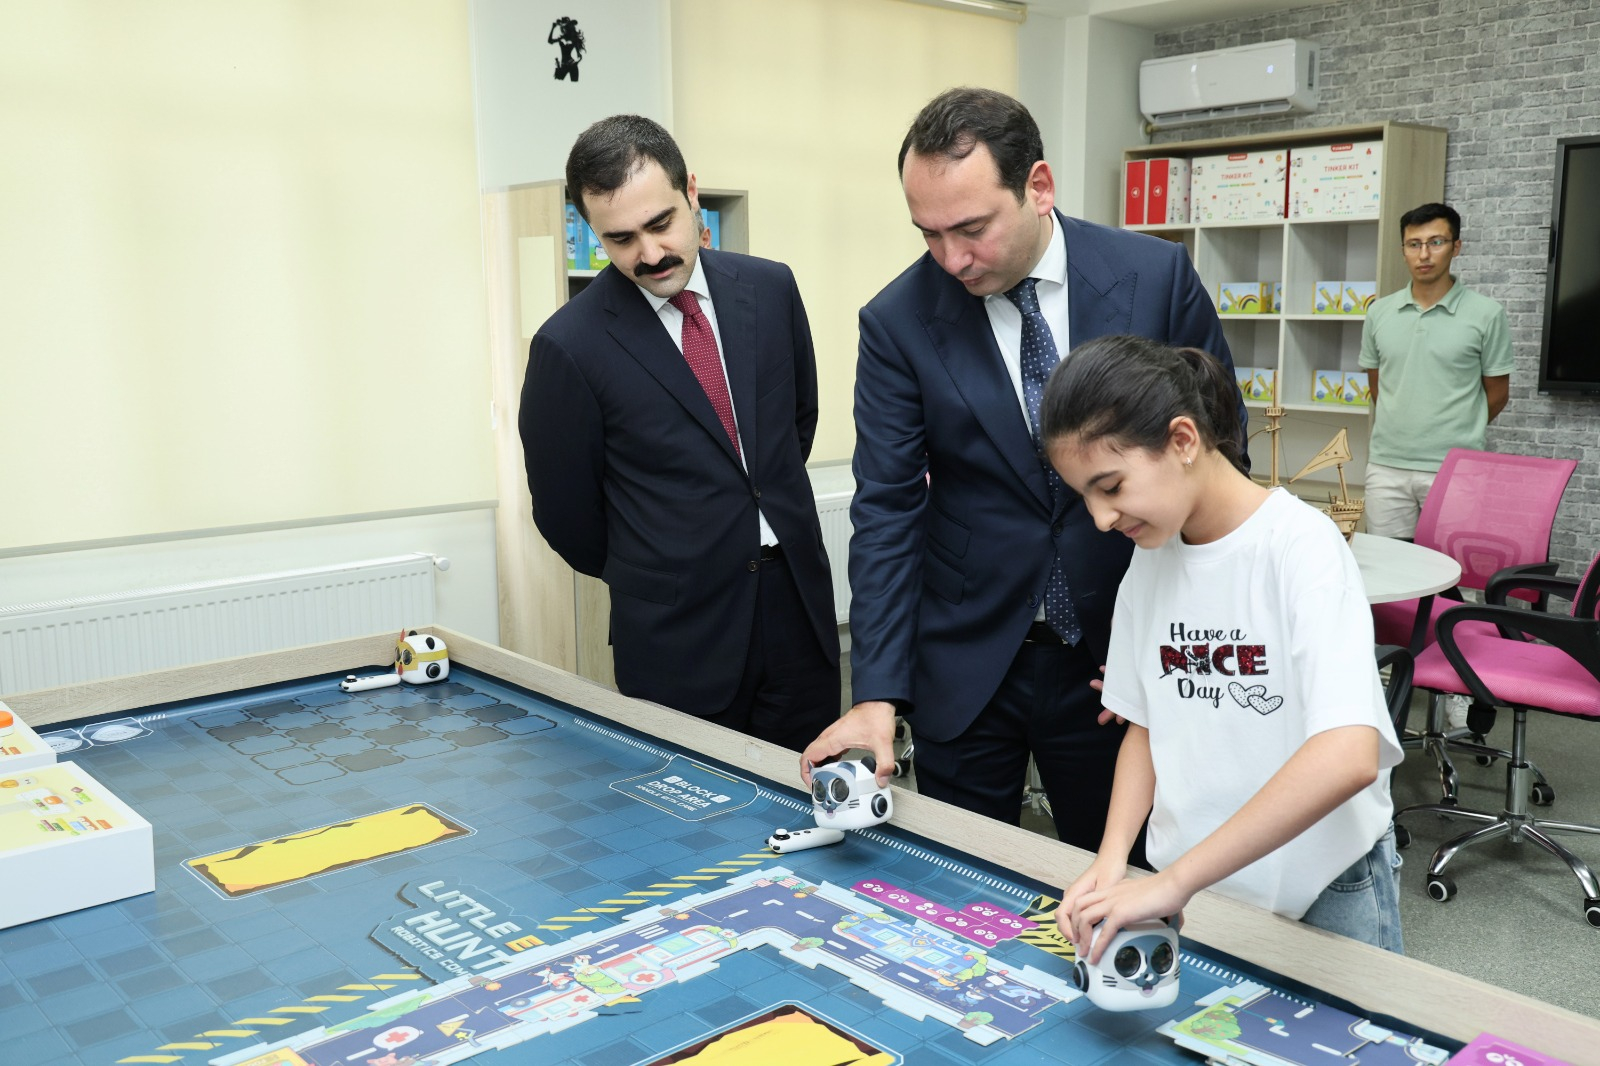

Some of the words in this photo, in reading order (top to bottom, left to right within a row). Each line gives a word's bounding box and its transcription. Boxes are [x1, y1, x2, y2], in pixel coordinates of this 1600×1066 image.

[1170, 622, 1227, 642] Have
[1230, 629, 1247, 641] a
[1159, 643, 1269, 679] NICE
[1177, 678, 1224, 709] Day
[645, 780, 683, 794] DROP
[677, 793, 712, 808] AREA
[675, 781, 717, 798] BLOCK
[417, 880, 522, 939] LITTLE
[390, 926, 445, 960] ROBOTICS
[404, 910, 514, 970] HUNT
[901, 923, 961, 951] POLICE
